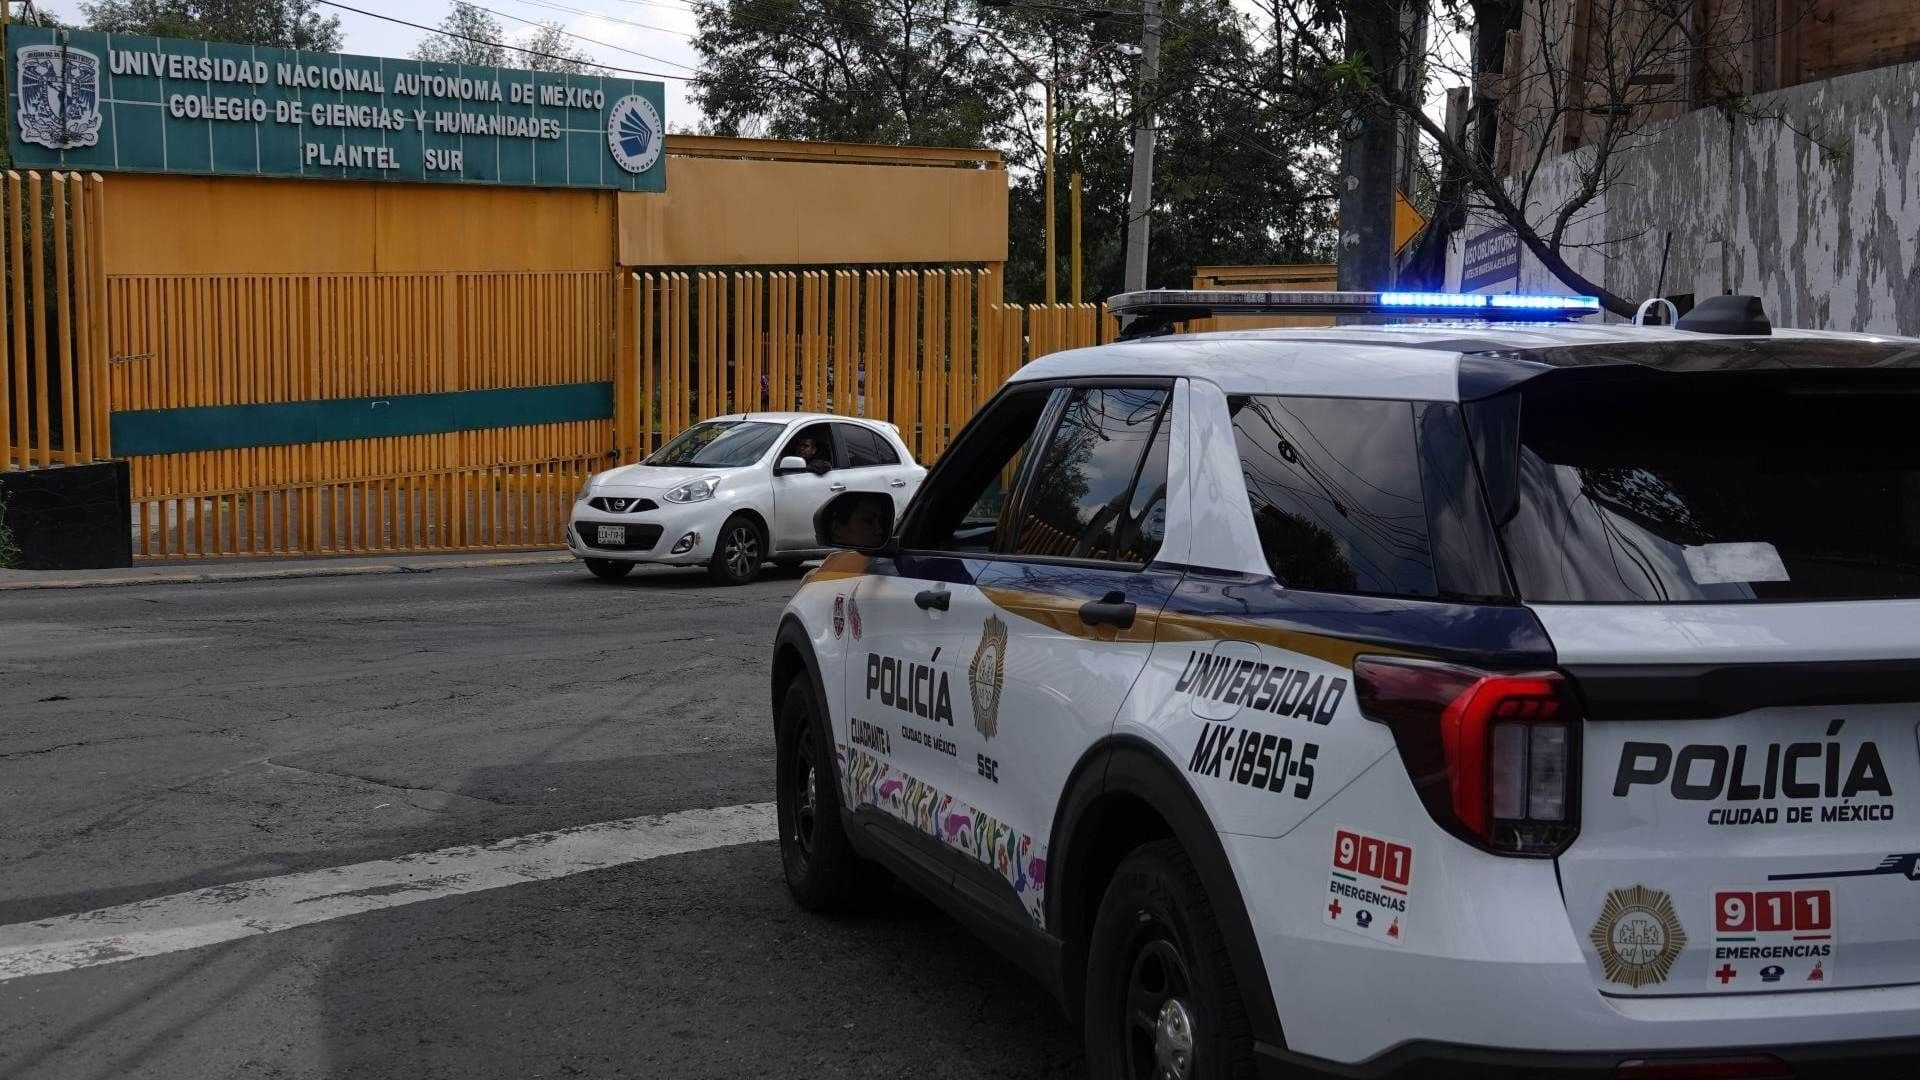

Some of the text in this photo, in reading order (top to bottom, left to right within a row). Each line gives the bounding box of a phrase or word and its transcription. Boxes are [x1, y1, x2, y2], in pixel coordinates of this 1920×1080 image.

[109, 50, 269, 84] UNIVERSIDAD
[276, 62, 385, 93] NACIONAL
[510, 82, 534, 104] DE
[169, 94, 561, 140] COLEGIO DE CIENCIAS Y HUMANIDADES
[305, 143, 463, 171] PLANTEL SUR
[866, 646, 954, 727] POLICÍA
[1175, 650, 1348, 726] UNIVERSIDAD
[851, 717, 886, 755] CUADRANTE
[901, 726, 957, 757] CIUDAD DE MÉXICO
[977, 752, 999, 784] SSC
[1612, 719, 1893, 801] POLICÍA
[1708, 800, 1894, 825] CIUDAD DE MÉXICO
[1339, 837, 1404, 879] 911
[1330, 880, 1406, 913] EMERGENCIAS
[1723, 895, 1820, 927] 911
[1715, 944, 1831, 959] EMERGENCIAS
